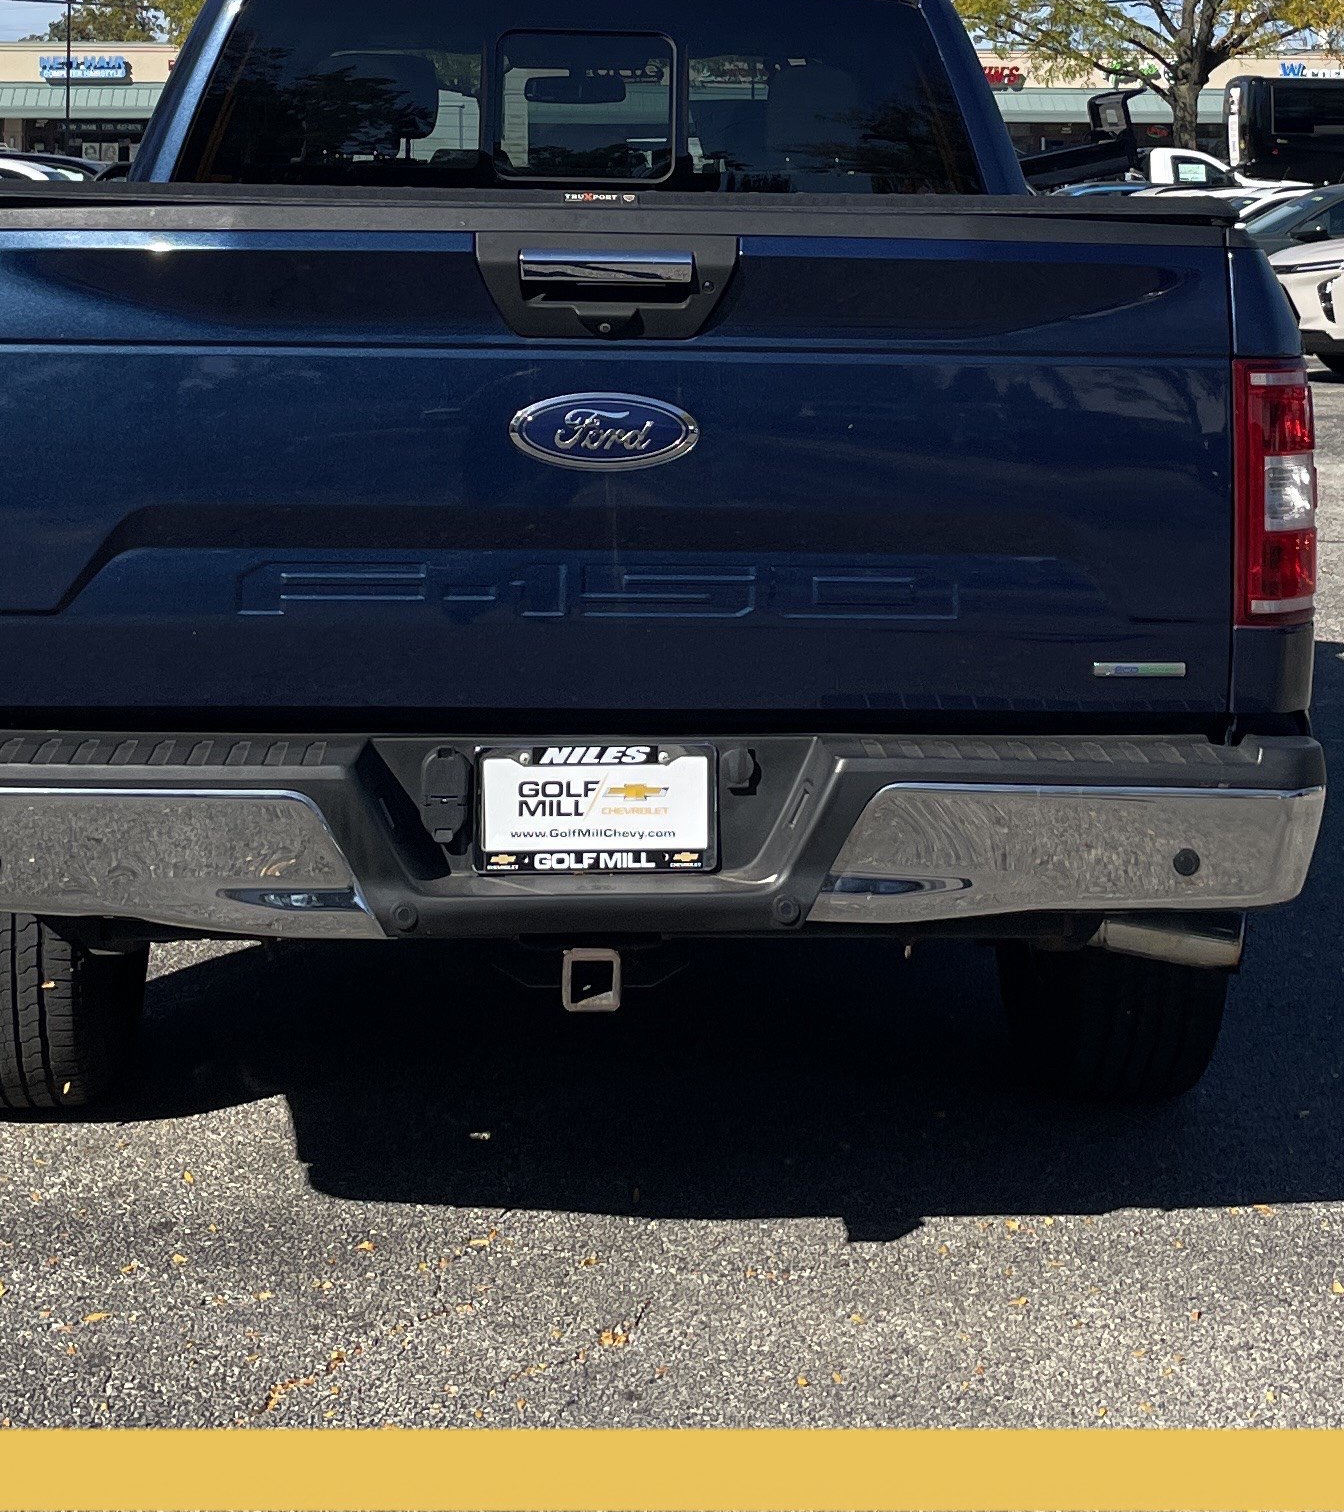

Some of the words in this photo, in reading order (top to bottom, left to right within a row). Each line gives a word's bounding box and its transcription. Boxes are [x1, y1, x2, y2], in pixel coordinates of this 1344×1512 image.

[42, 68, 83, 78] COMPTER
[564, 193, 618, 202] TRUXPORT
[555, 408, 654, 450] Ford
[236, 560, 959, 620] F-150
[539, 746, 651, 764] NILES
[518, 780, 600, 798] GOLF
[518, 799, 584, 817] MILL
[601, 807, 670, 815] CHEVROLET
[510, 828, 676, 839] www.GolfMillChevy.com
[534, 853, 597, 869] GOLF
[599, 852, 656, 868] MILL
